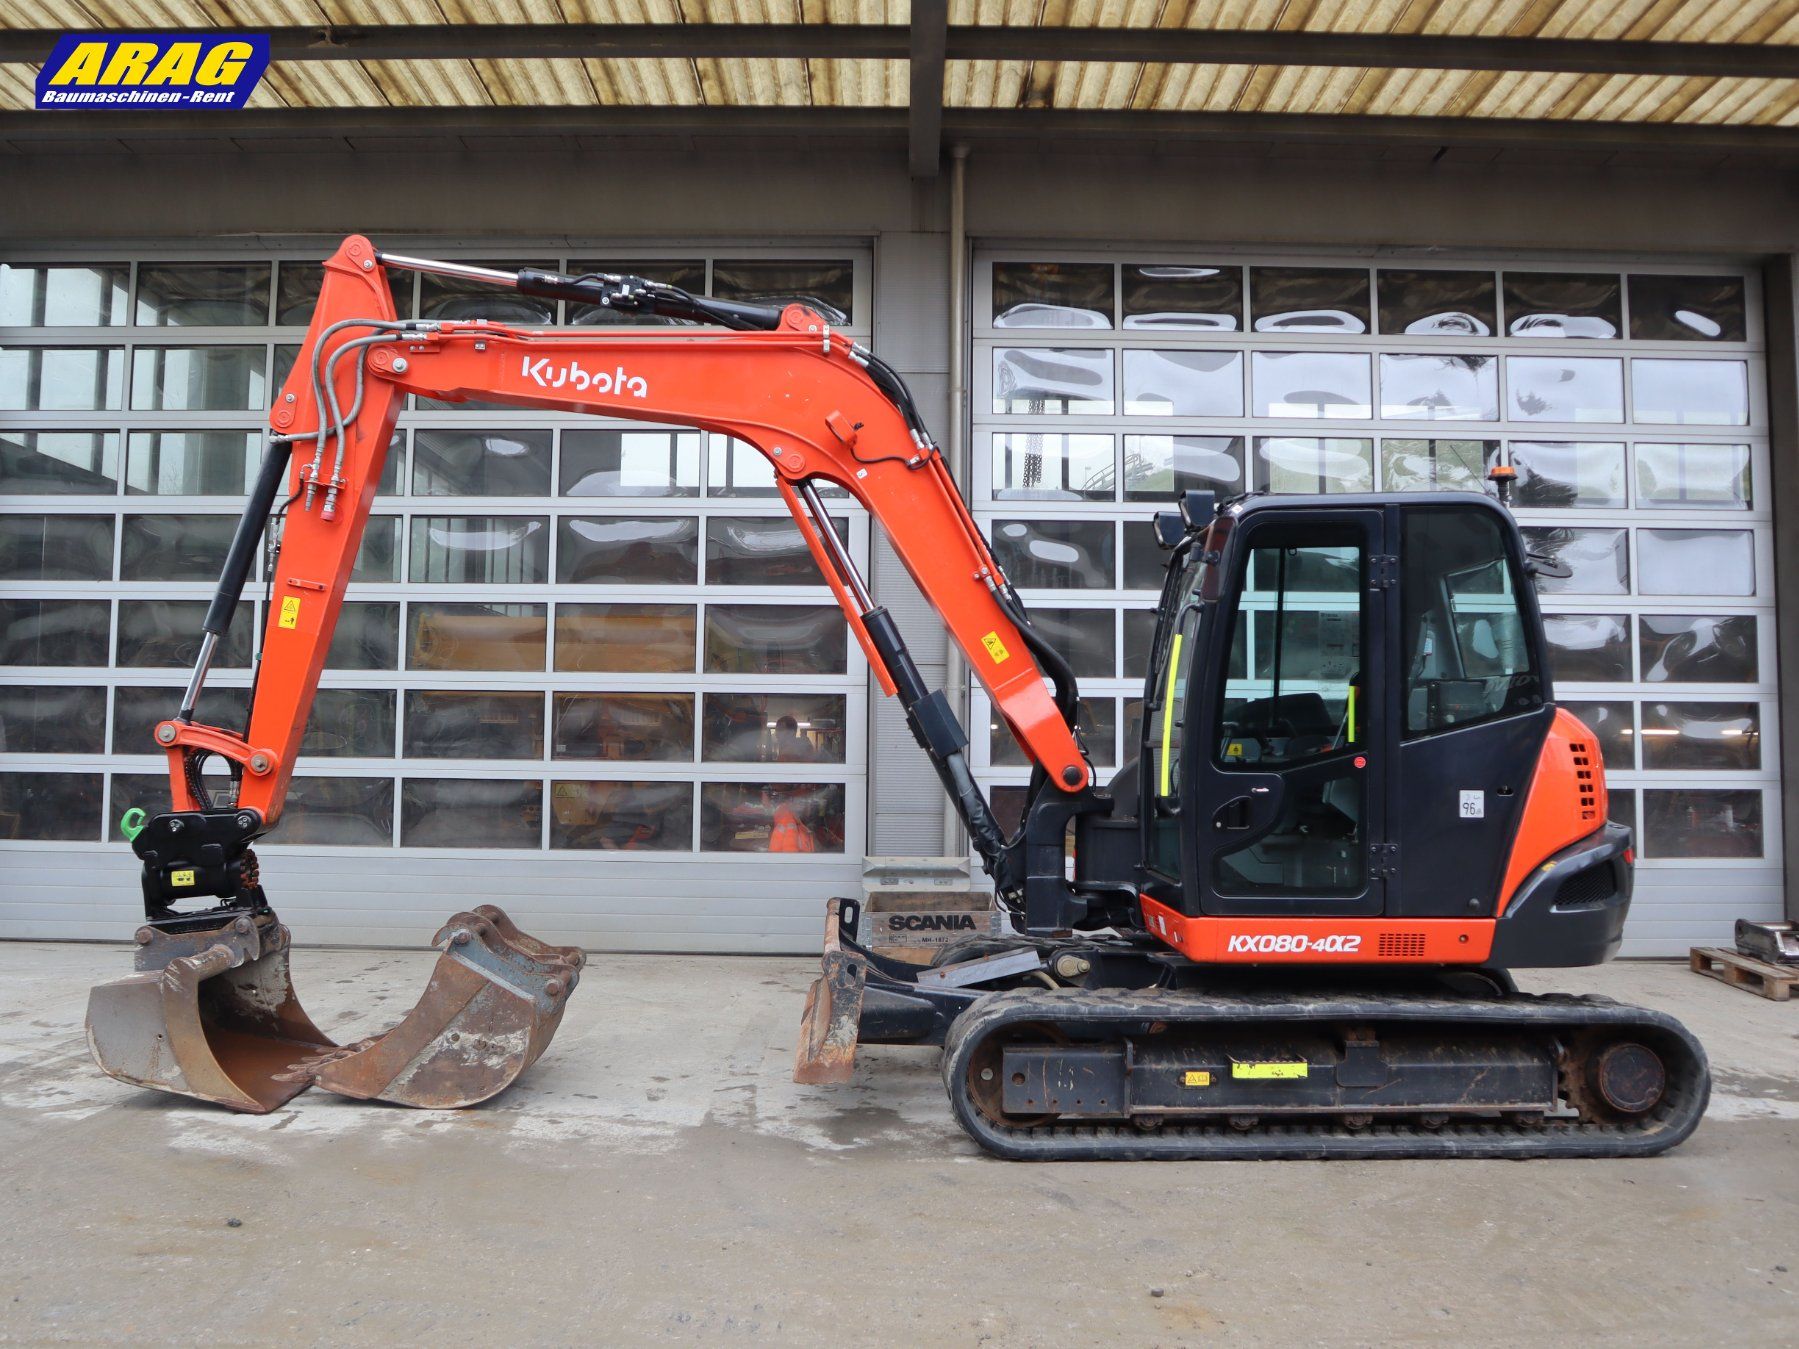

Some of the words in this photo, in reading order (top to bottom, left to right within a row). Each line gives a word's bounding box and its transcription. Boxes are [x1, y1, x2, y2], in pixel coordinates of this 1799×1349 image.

[521, 356, 648, 398] Kubota
[1463, 802, 1475, 815] 96
[888, 915, 976, 930] SCANIA
